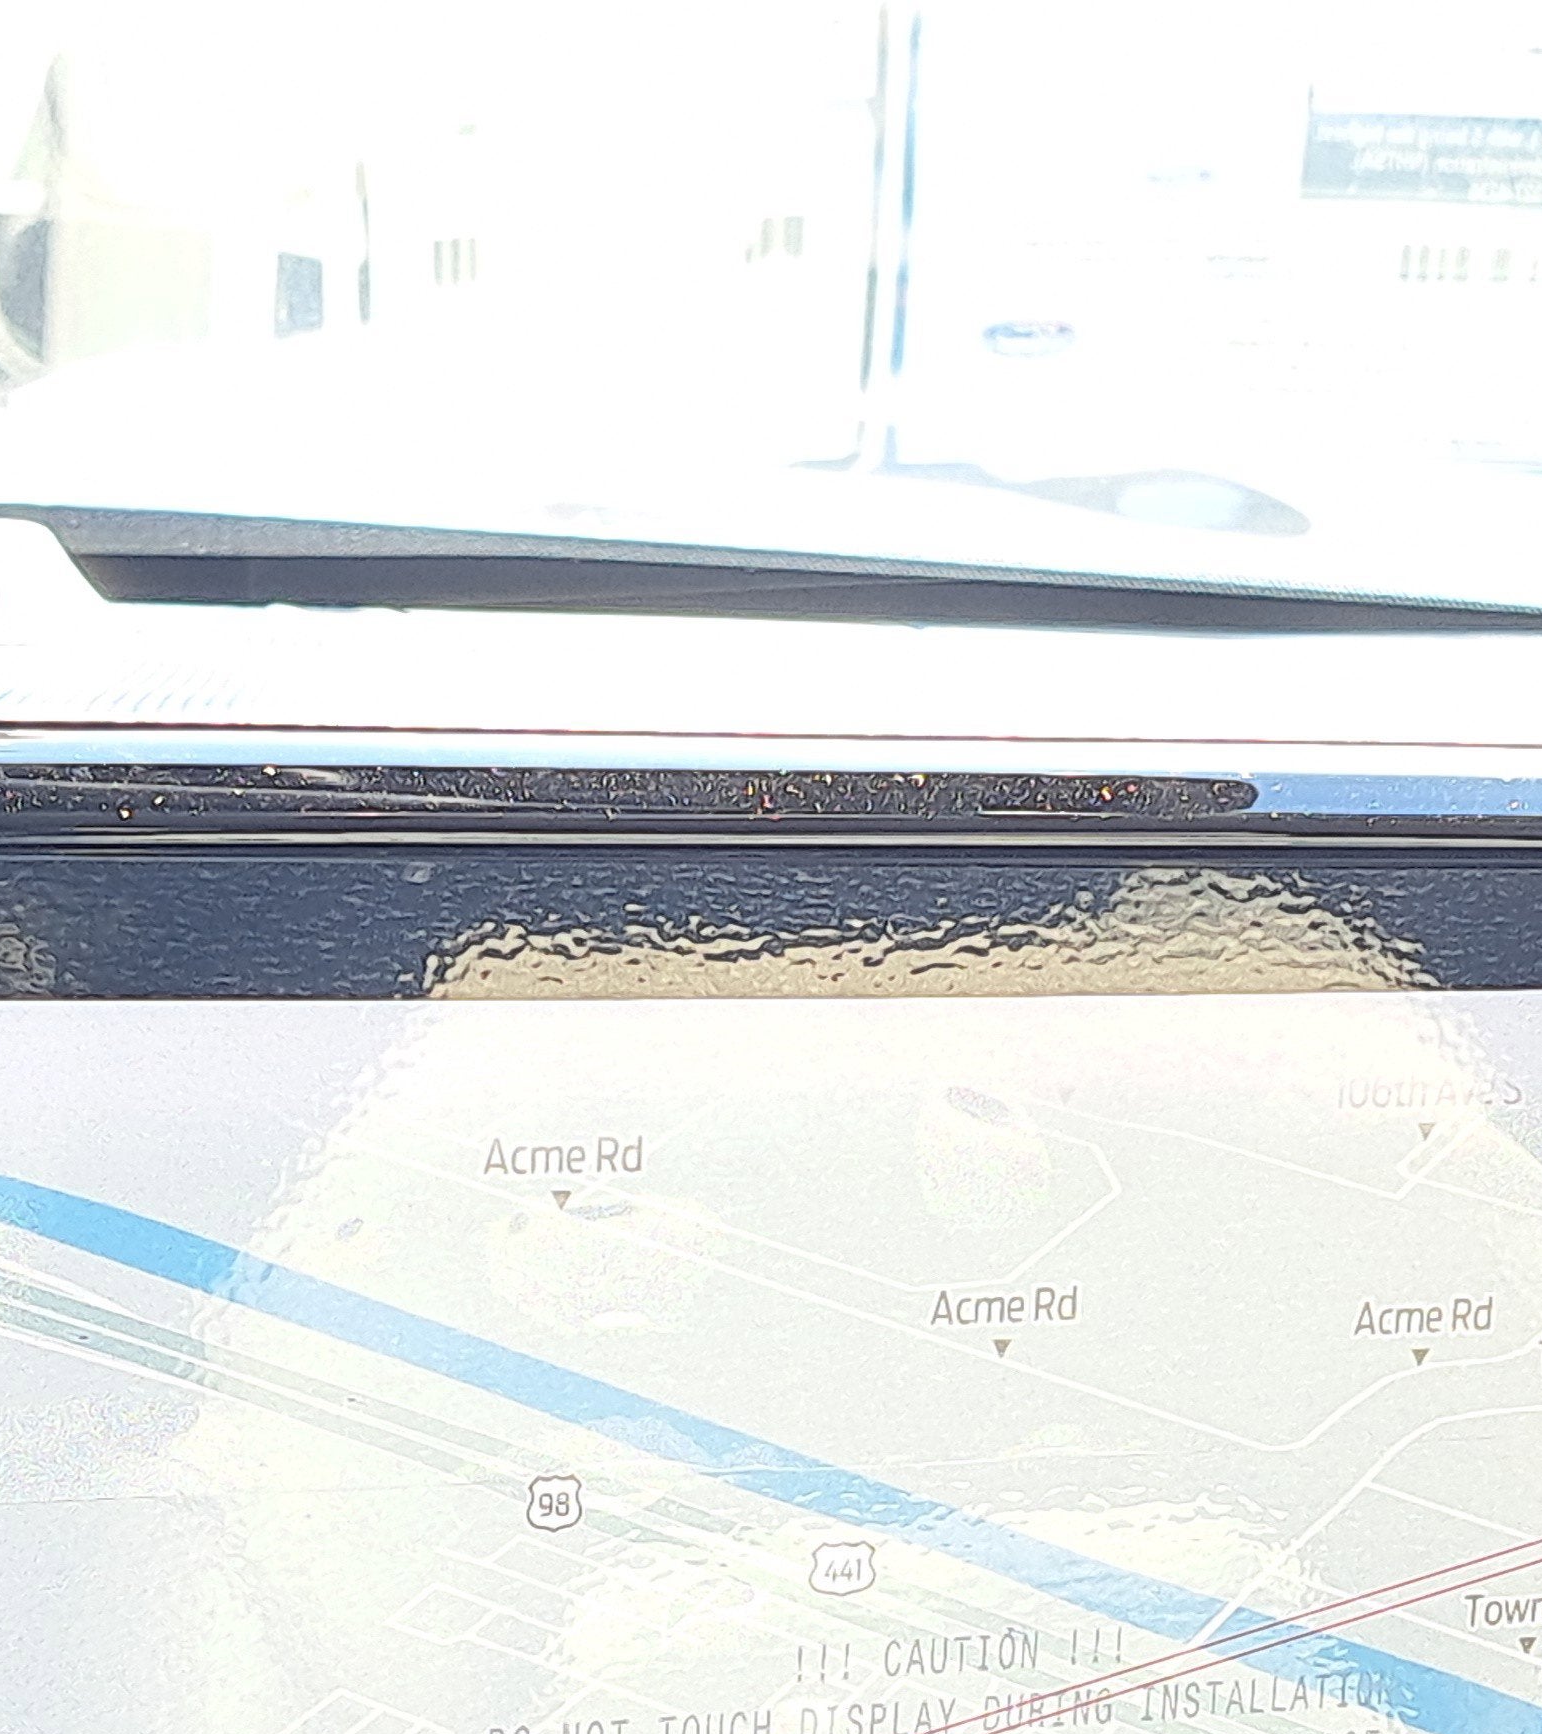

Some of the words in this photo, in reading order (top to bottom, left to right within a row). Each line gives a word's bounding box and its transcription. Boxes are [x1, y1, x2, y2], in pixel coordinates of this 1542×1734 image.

[483, 1137, 587, 1175] Acme
[595, 1135, 644, 1173] Rd
[931, 1290, 1027, 1325] Acme
[1034, 1285, 1079, 1321] Rd
[1354, 1301, 1444, 1336] Acme
[1452, 1297, 1494, 1331] Rd
[538, 1492, 570, 1518] 98
[824, 1556, 863, 1583] 441
[884, 1628, 1040, 1677] CAUTION
[983, 1687, 1113, 1732] DURING
[1141, 1668, 1395, 1722] INSTALLATION
